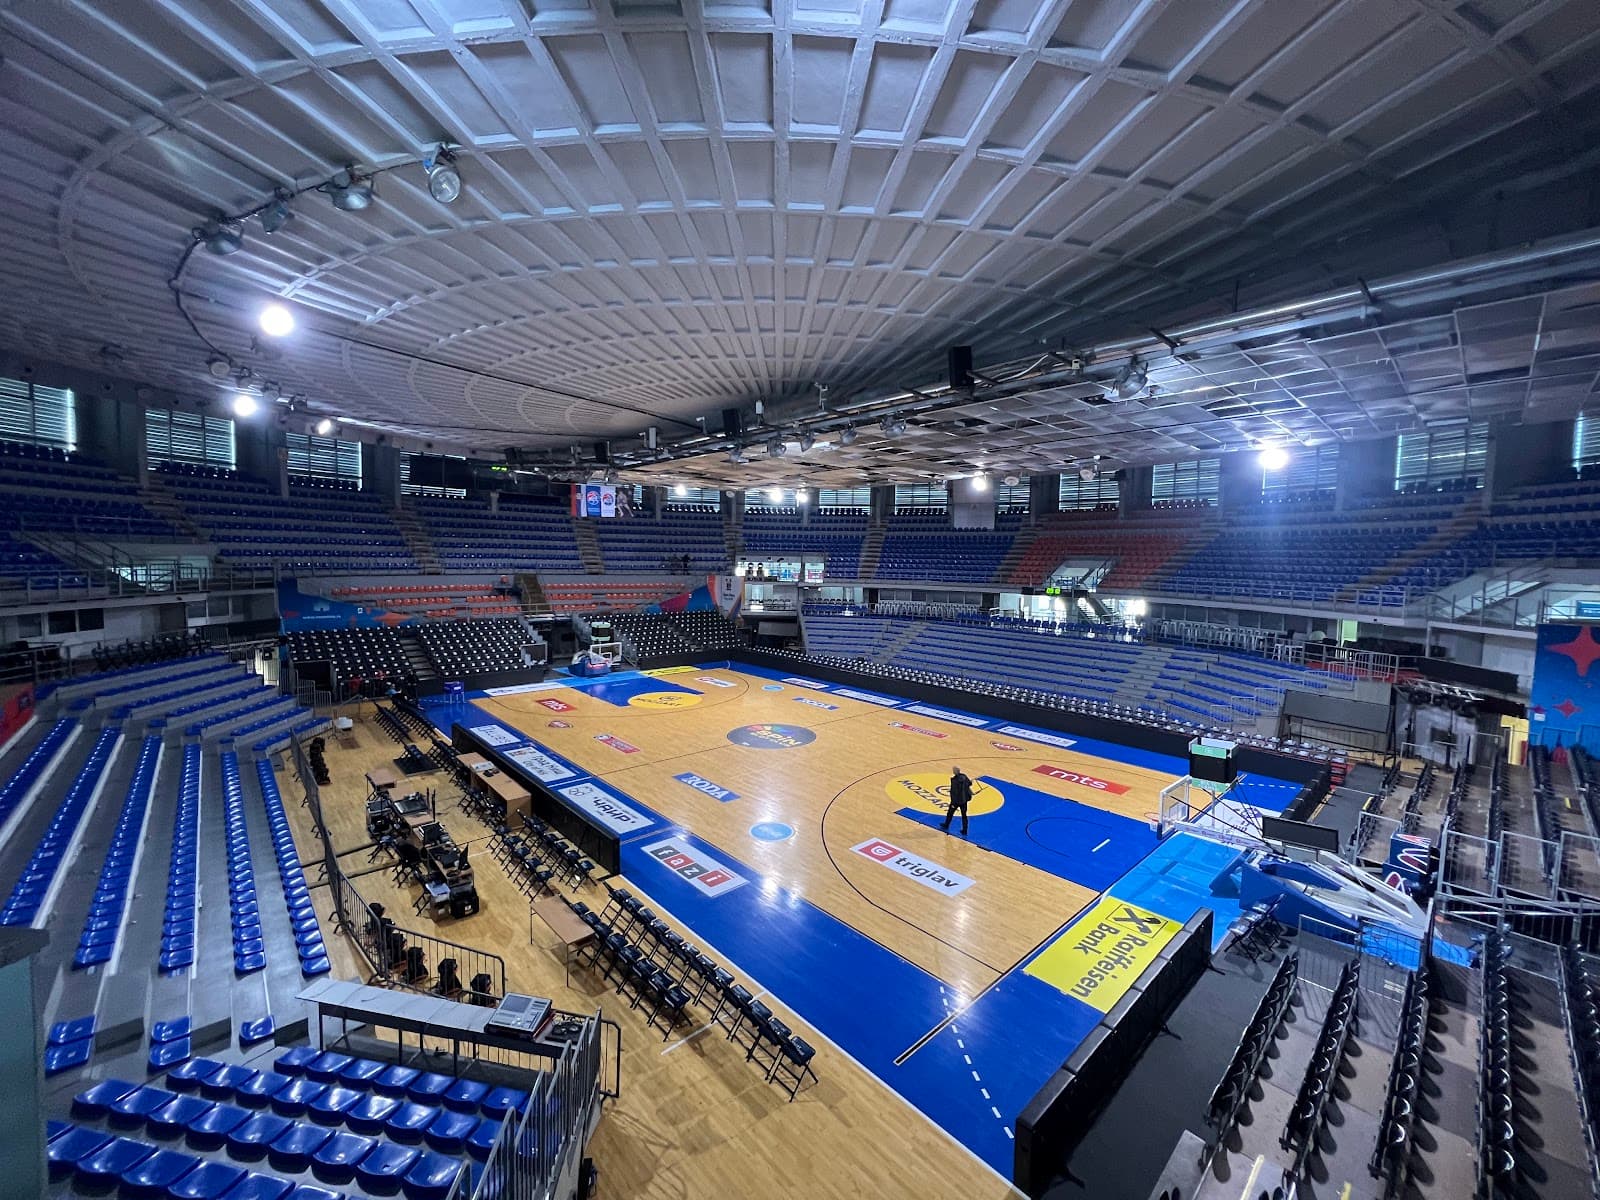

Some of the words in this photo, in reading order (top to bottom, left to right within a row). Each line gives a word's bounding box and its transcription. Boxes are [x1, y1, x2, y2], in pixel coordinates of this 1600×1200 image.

[681, 775, 729, 799] RODA
[897, 779, 961, 813] MOZZAR
[1049, 769, 1108, 790] mts
[656, 848, 724, 883] fazi
[895, 856, 960, 888] triglav
[1072, 922, 1121, 955] Bank
[1070, 933, 1149, 998] Raiffeisen
